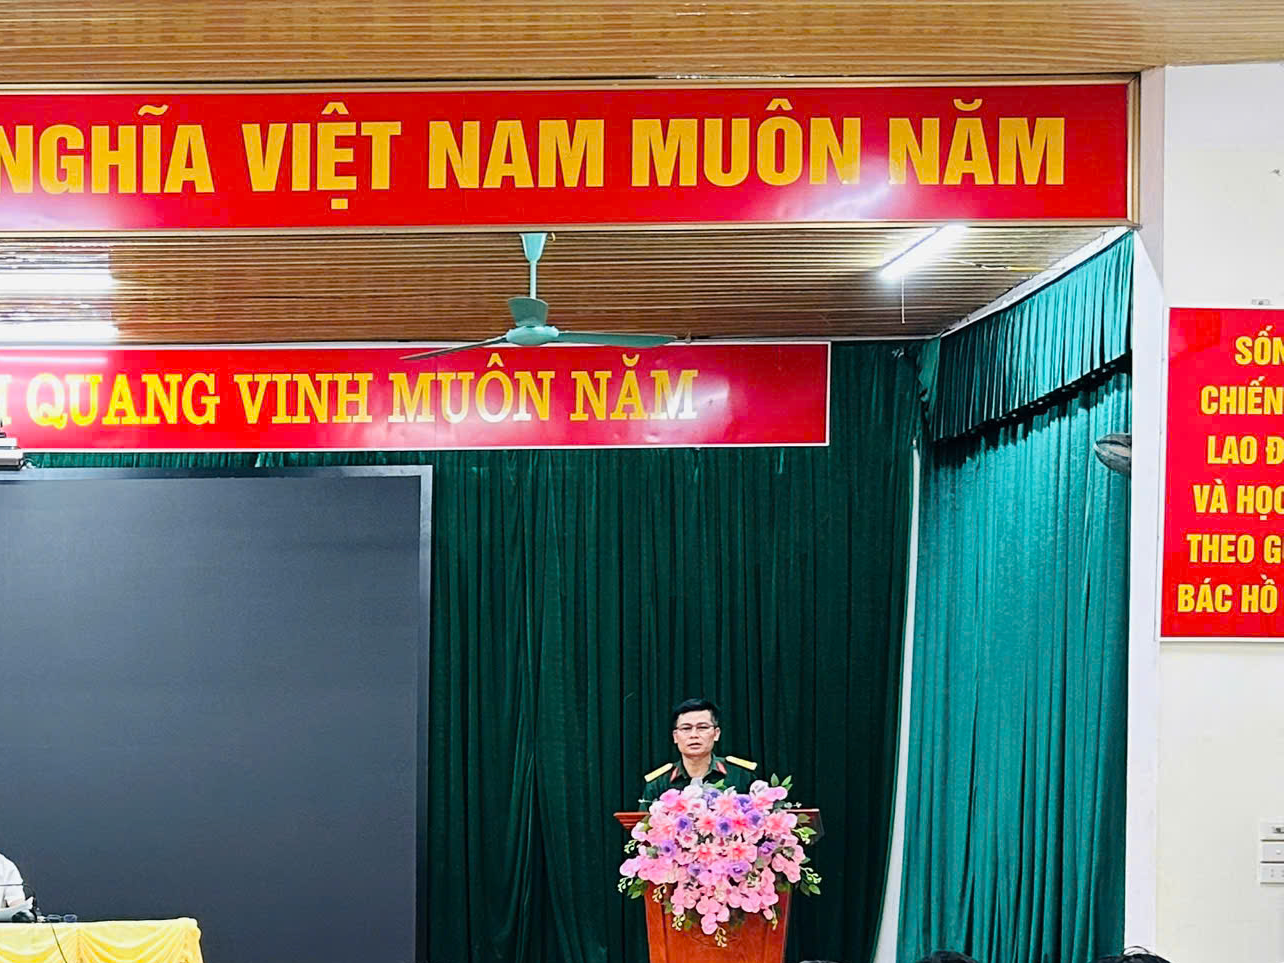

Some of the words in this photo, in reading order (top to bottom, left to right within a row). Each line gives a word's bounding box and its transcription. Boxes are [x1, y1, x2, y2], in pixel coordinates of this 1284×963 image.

[242, 102, 402, 210] VIỆT
[428, 119, 605, 190] NAM
[631, 98, 861, 187] MUÔN
[888, 98, 1065, 186] NĂM
[26, 372, 221, 430] QUANG
[233, 372, 373, 425] VINH
[387, 353, 556, 424] MUÔN
[570, 355, 698, 421] NĂM
[1207, 435, 1258, 465] LAO
[1192, 478, 1229, 514] VÀ
[1186, 534, 1255, 564] THEO
[1177, 577, 1233, 613] BÁC
[1241, 573, 1278, 614] HỒ
